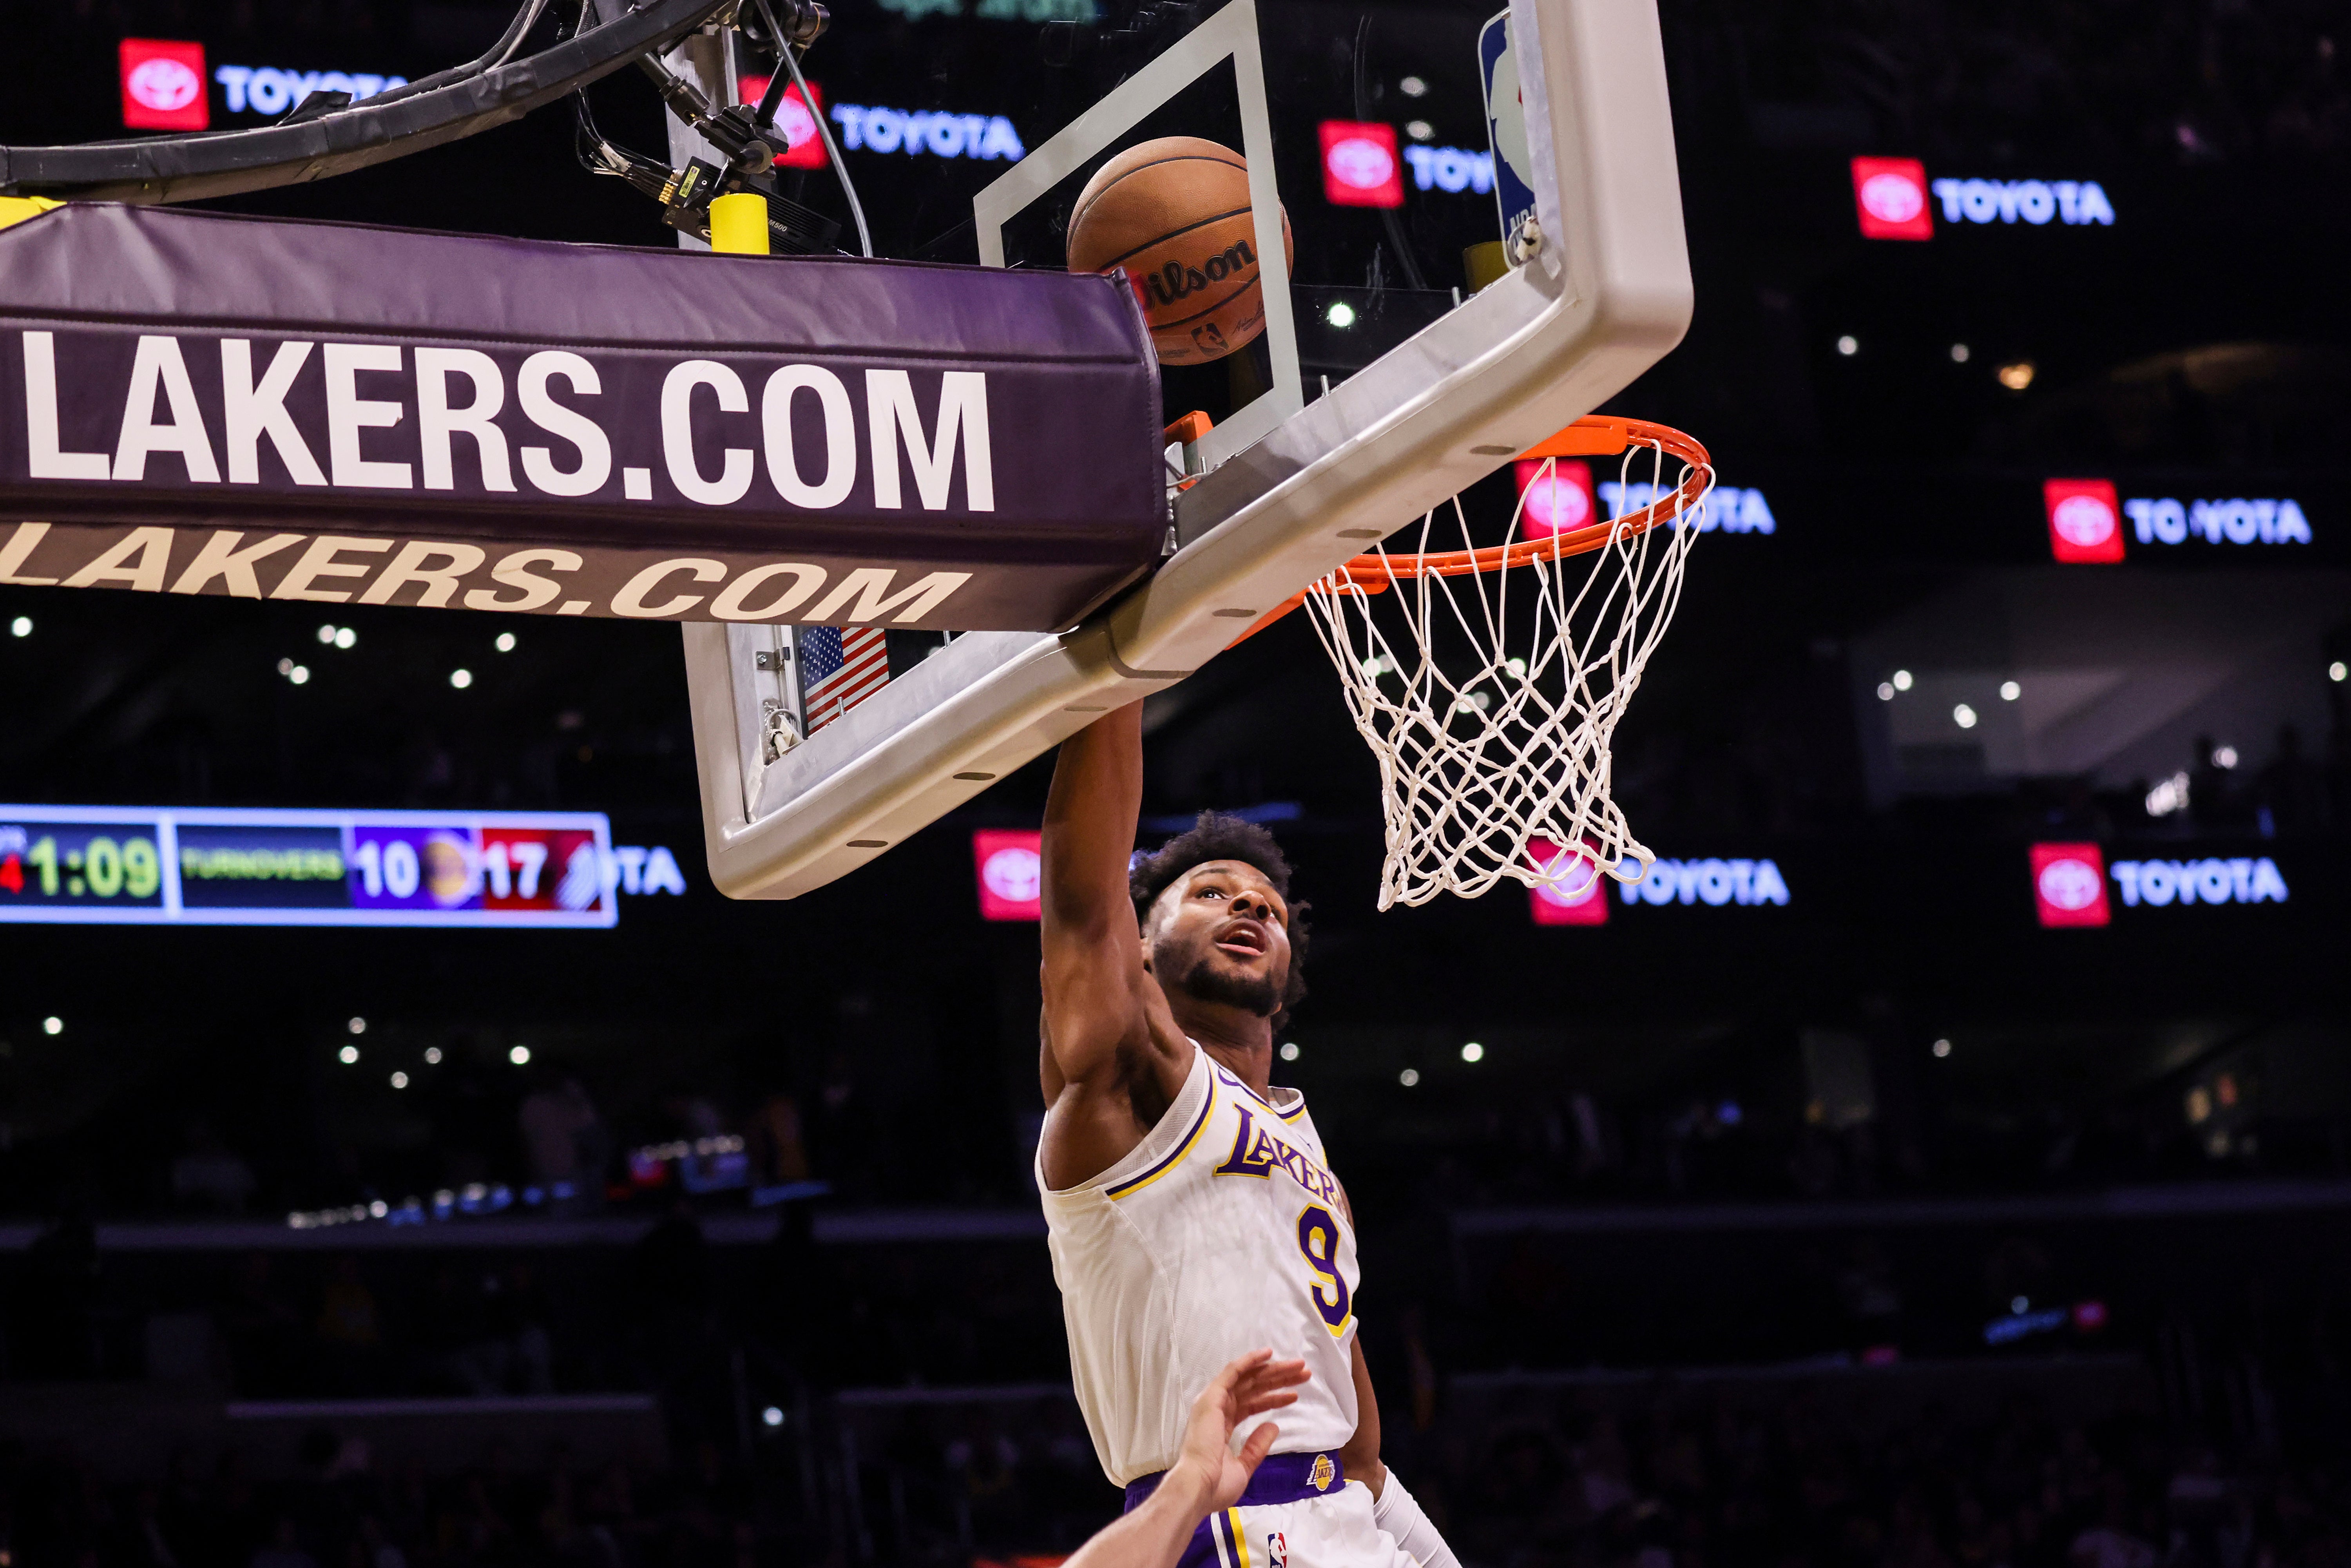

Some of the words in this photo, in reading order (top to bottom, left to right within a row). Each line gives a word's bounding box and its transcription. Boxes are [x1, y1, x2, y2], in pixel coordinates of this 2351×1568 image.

[831, 103, 1025, 161] TOYOTA
[1932, 177, 2116, 226] TOYOTA
[23, 331, 994, 511] LAKERS.COM
[0, 522, 973, 623] LAKERS.COM
[29, 835, 159, 898] 1:09
[356, 839, 419, 899] 10
[484, 841, 548, 899] 17
[611, 846, 687, 896] TA
[1614, 857, 1791, 906] TOYOTA
[2110, 857, 2289, 907] TOYOTA
[1213, 1101, 1346, 1218] LAKER
[1297, 1202, 1352, 1338] 9
